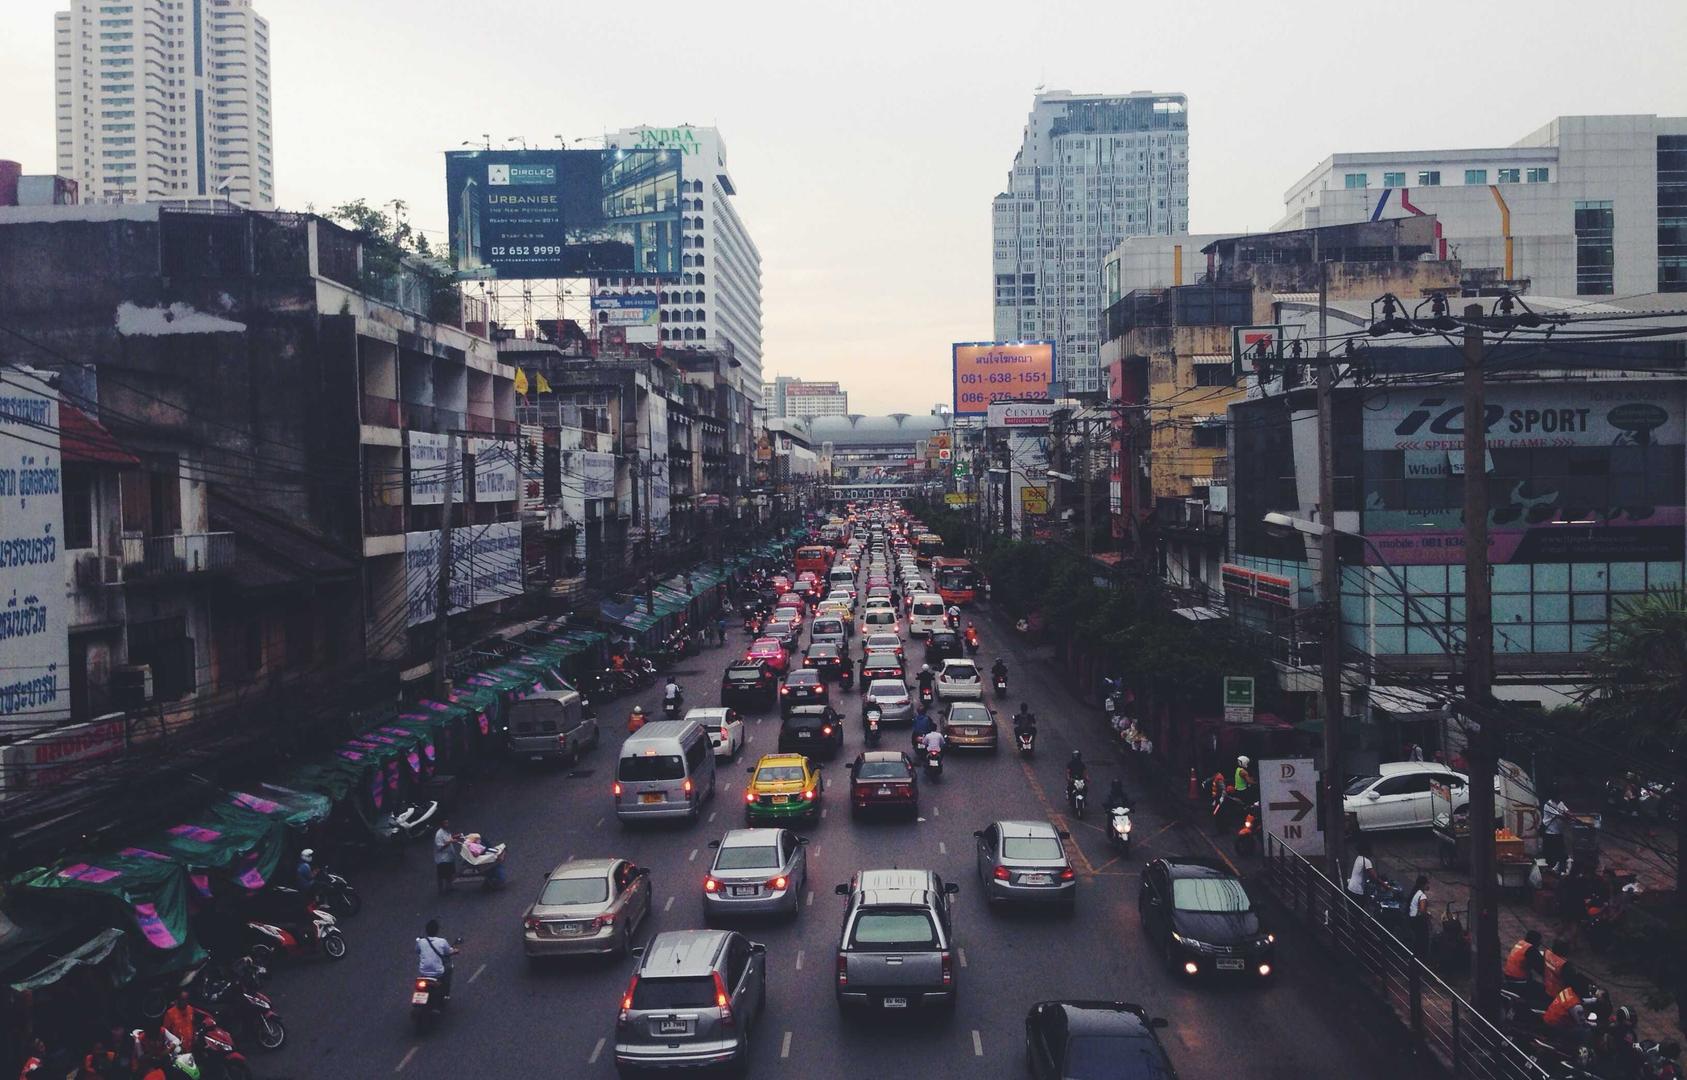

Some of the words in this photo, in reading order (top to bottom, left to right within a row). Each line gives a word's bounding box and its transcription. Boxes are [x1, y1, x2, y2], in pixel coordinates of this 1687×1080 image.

[641, 129, 694, 142] INDRA
[488, 194, 558, 204] URBANISE
[491, 246, 505, 255] 02
[508, 246, 530, 255] 652
[533, 246, 561, 255] 9999
[961, 372, 1047, 384] 081-638-1551
[961, 391, 1048, 403] 086-376-1522
[1509, 408, 1590, 433] SPORT
[1283, 825, 1303, 839] IN
